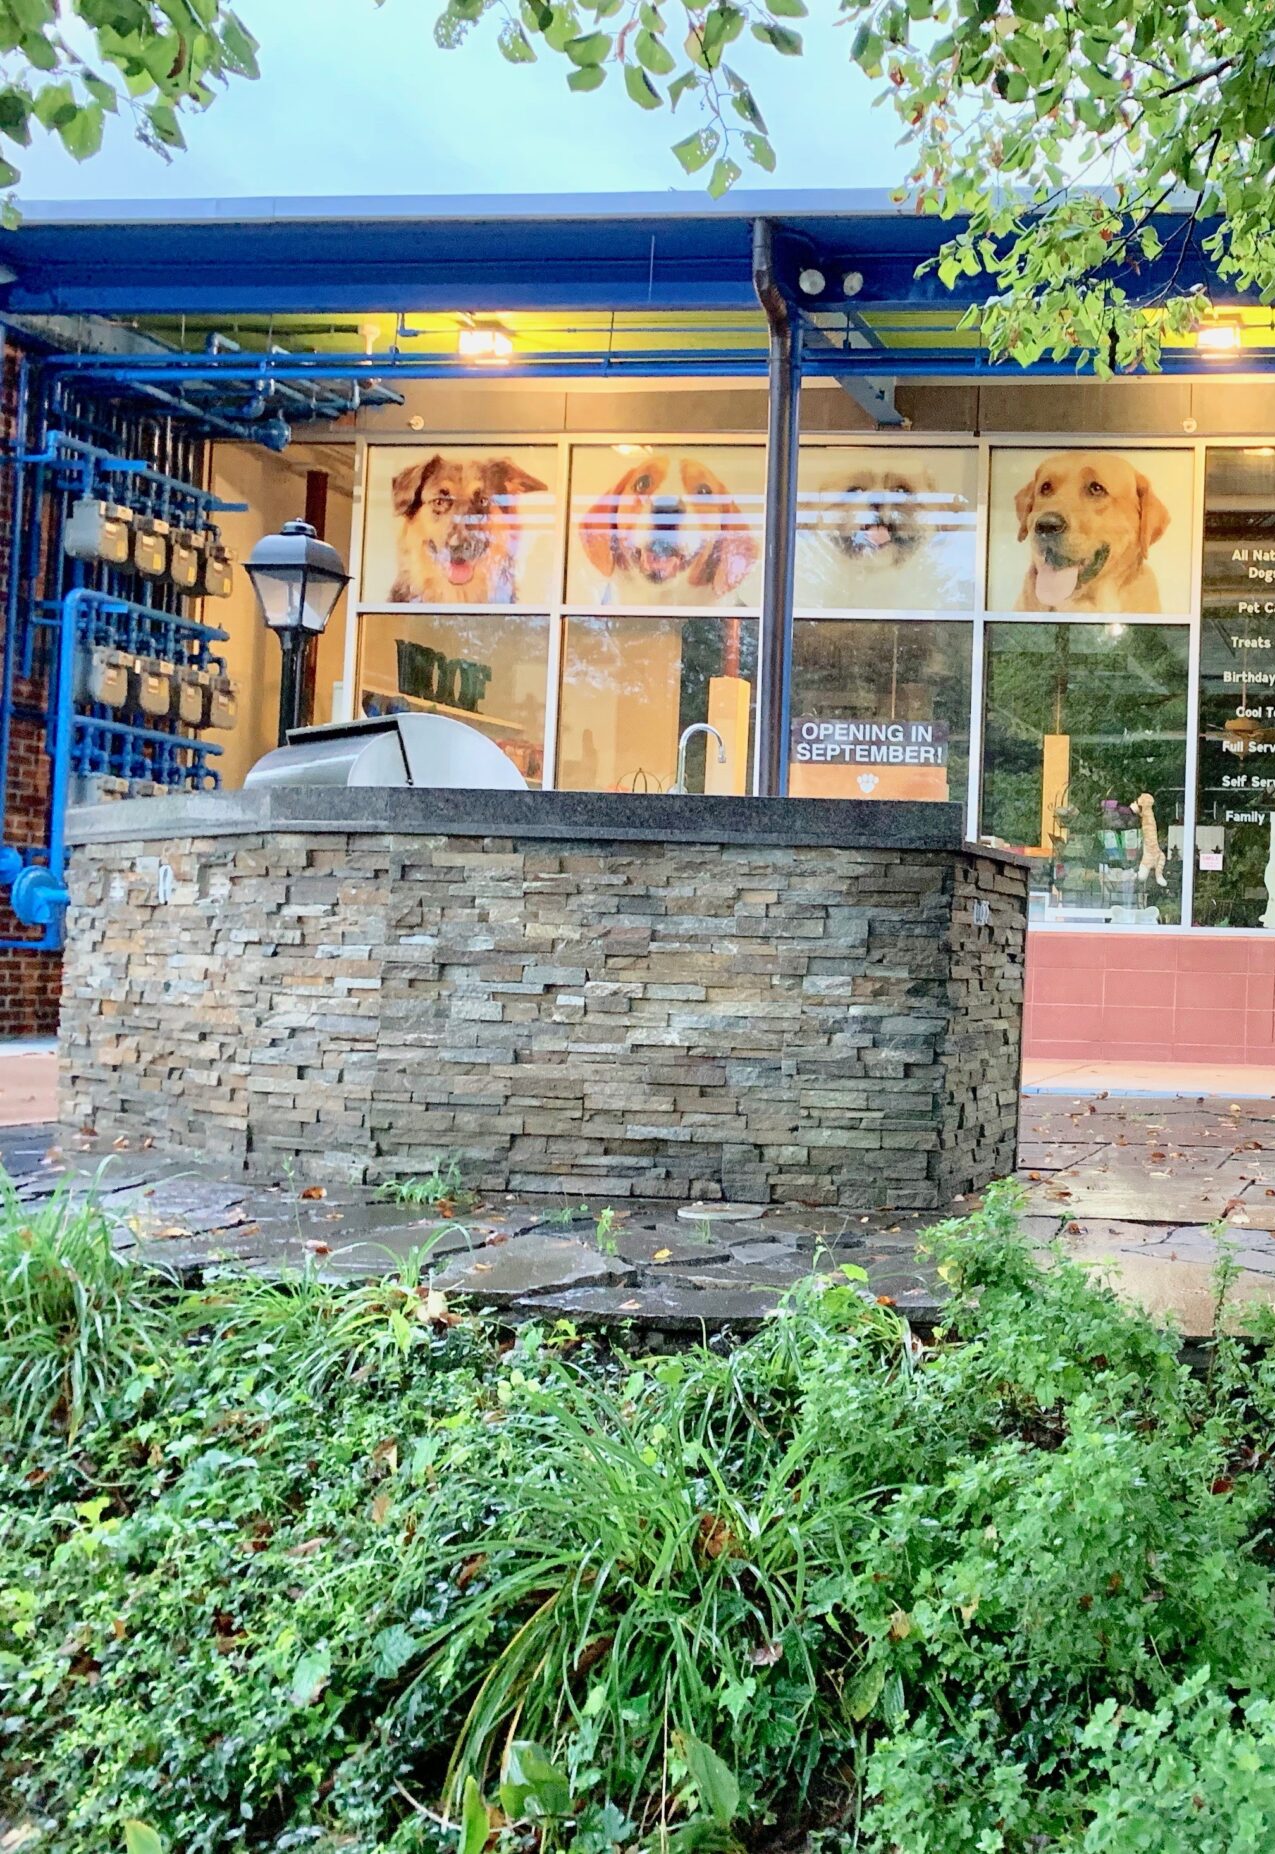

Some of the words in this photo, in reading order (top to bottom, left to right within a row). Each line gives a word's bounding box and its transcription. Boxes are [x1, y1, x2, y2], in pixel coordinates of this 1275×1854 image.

[1231, 549, 1249, 562] All
[1238, 602, 1260, 614] Pet
[1230, 636, 1271, 649] Treats
[1223, 671, 1275, 685] Birthday
[1236, 706, 1262, 719] Cool
[801, 722, 904, 741] OPENING
[911, 725, 933, 742] IN
[796, 742, 943, 764] SEPTEMBER!
[1222, 741, 1243, 753] Full
[1222, 775, 1248, 788] Self
[1225, 810, 1266, 825] Family
